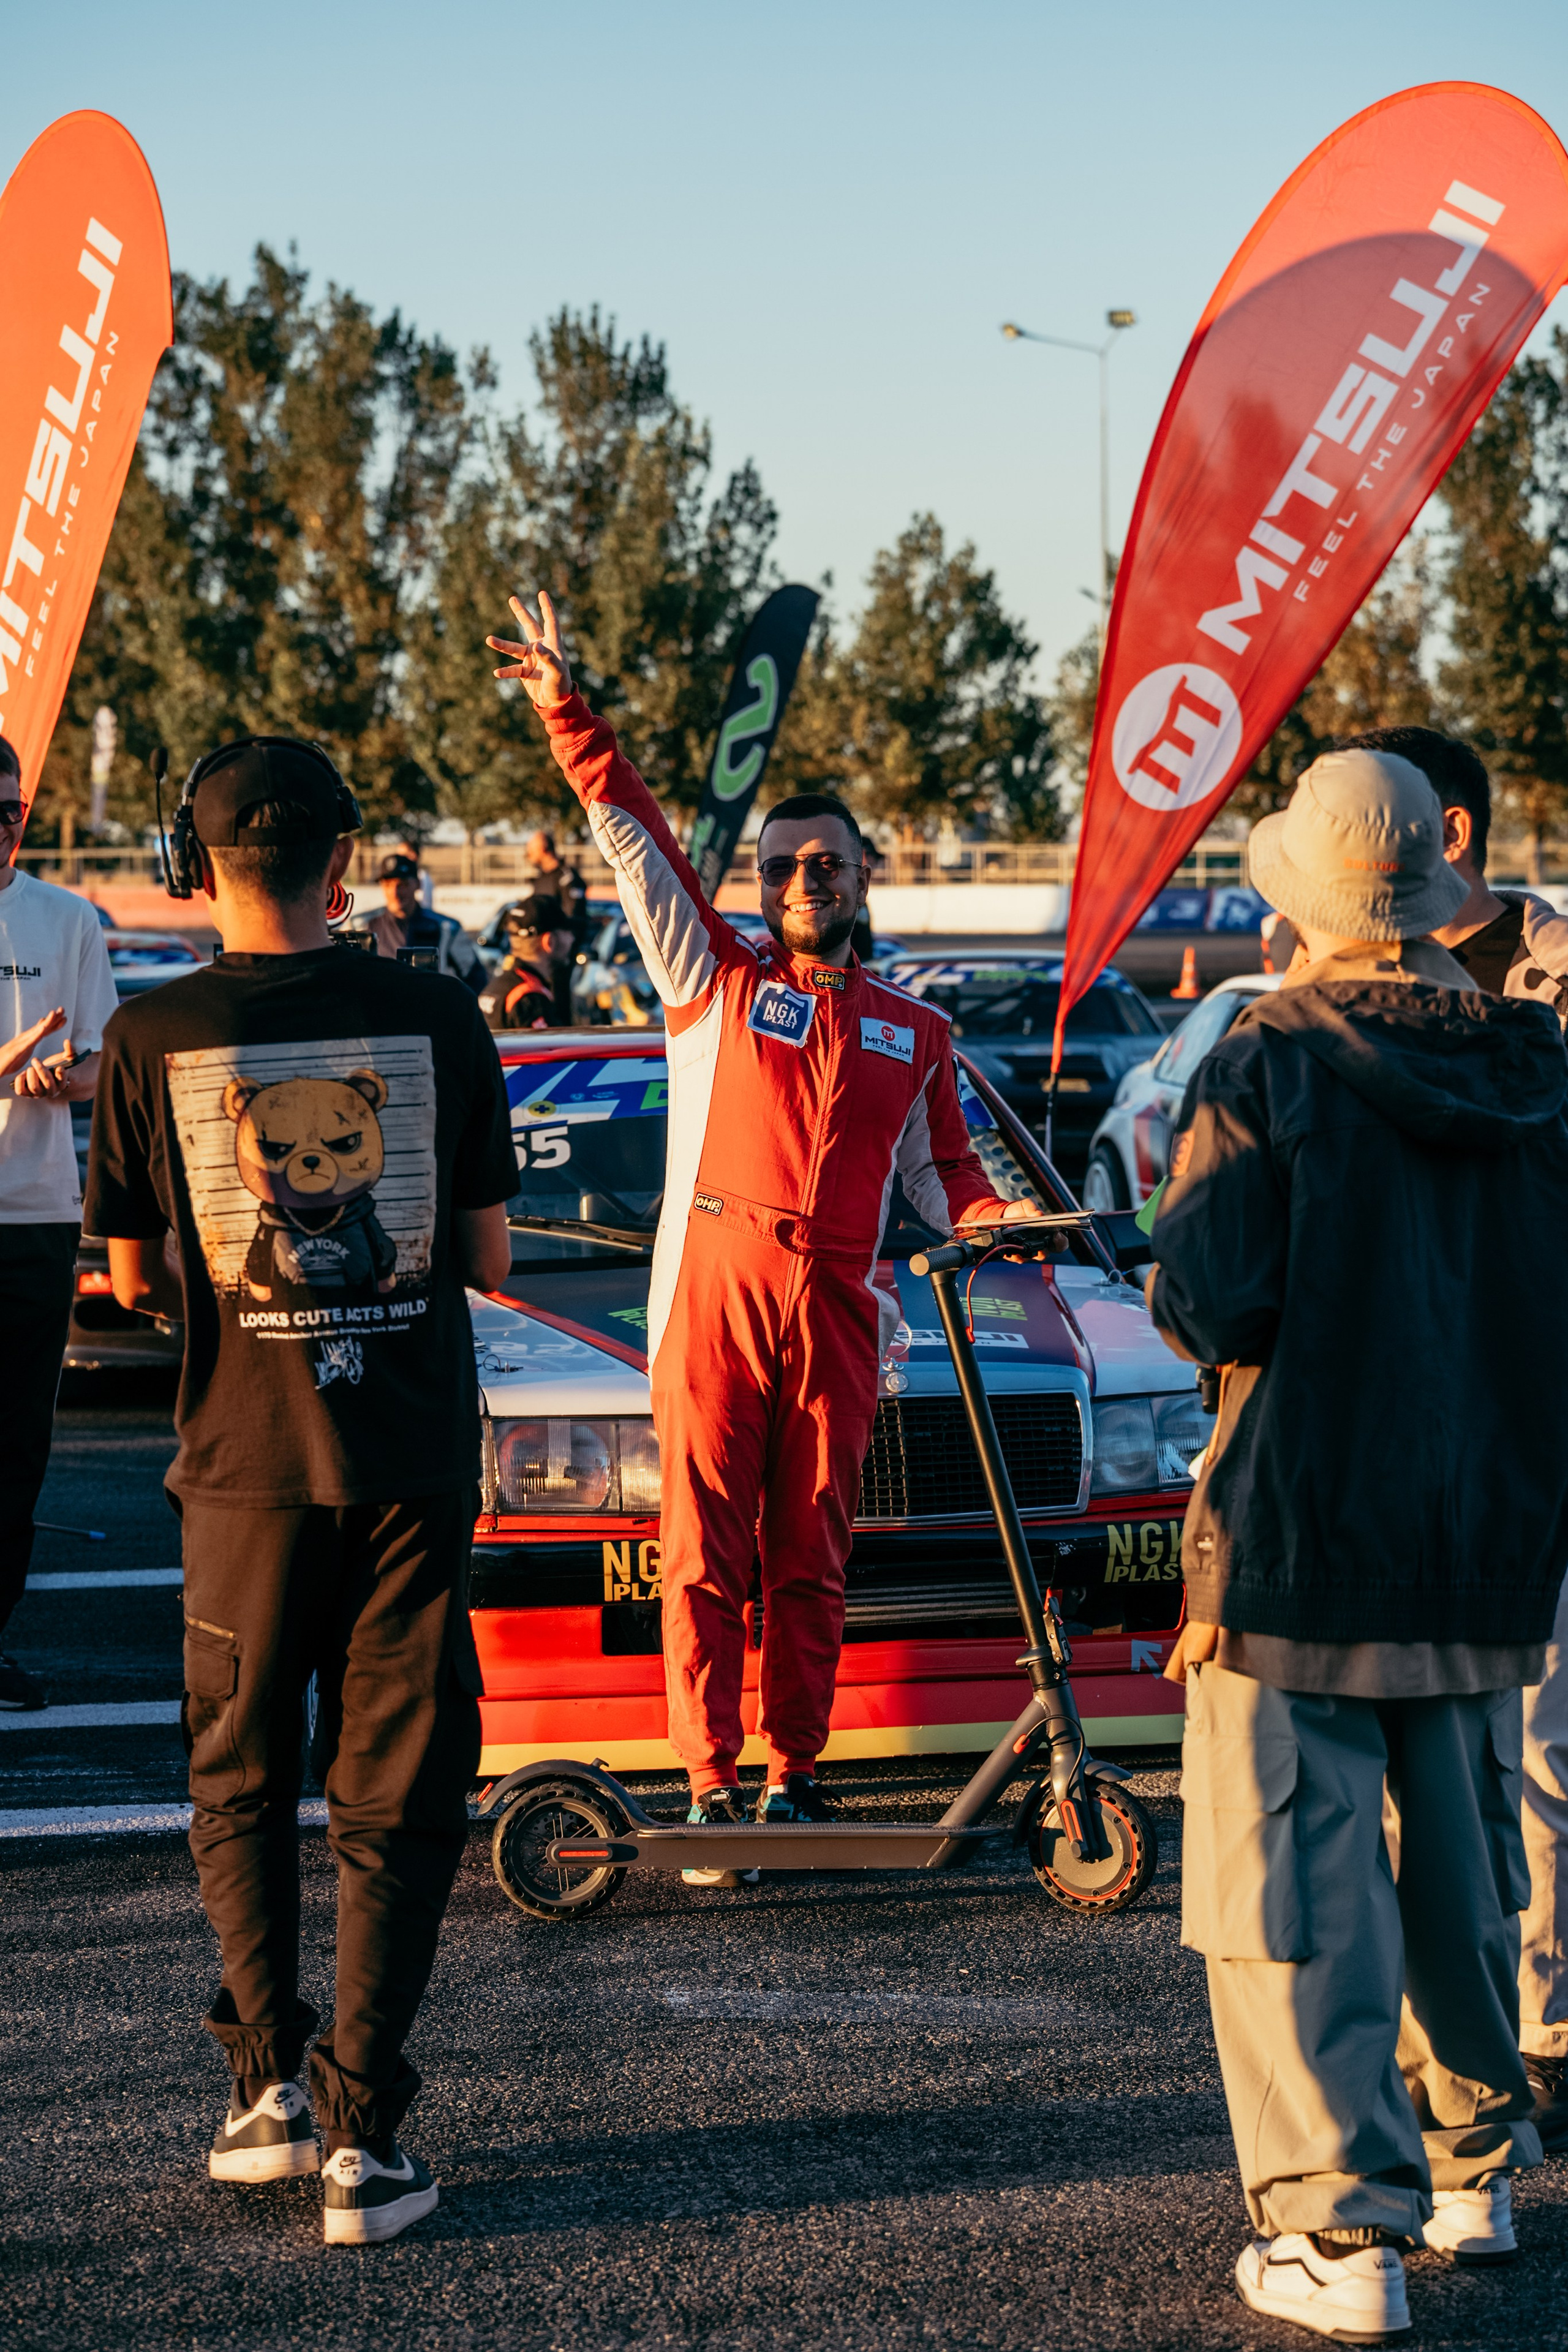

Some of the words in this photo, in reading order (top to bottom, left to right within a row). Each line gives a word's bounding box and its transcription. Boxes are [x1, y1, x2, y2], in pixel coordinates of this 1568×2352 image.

[1196, 179, 1507, 656] MITSUJI
[1293, 511, 1358, 602] FEEL
[1357, 426, 1406, 492] THE
[1411, 282, 1491, 409] JAPAN
[25, 579, 58, 677] FEEL
[55, 481, 80, 557] THE
[80, 330, 119, 467] JAPAN
[0, 966, 40, 977] SUJI
[816, 974, 843, 986] OMP
[763, 1000, 800, 1023] NGK
[766, 1014, 797, 1030] PLAST
[865, 1036, 911, 1055] MITSUJI
[696, 1197, 720, 1212] OMP
[288, 1238, 314, 1264] NEW
[315, 1238, 350, 1260] YORK
[239, 1312, 290, 1328] LOOKS
[293, 1307, 344, 1327] CUTE
[345, 1306, 385, 1322] ACTS
[388, 1299, 427, 1319] WILD
[1112, 1562, 1186, 1583] PLAS
